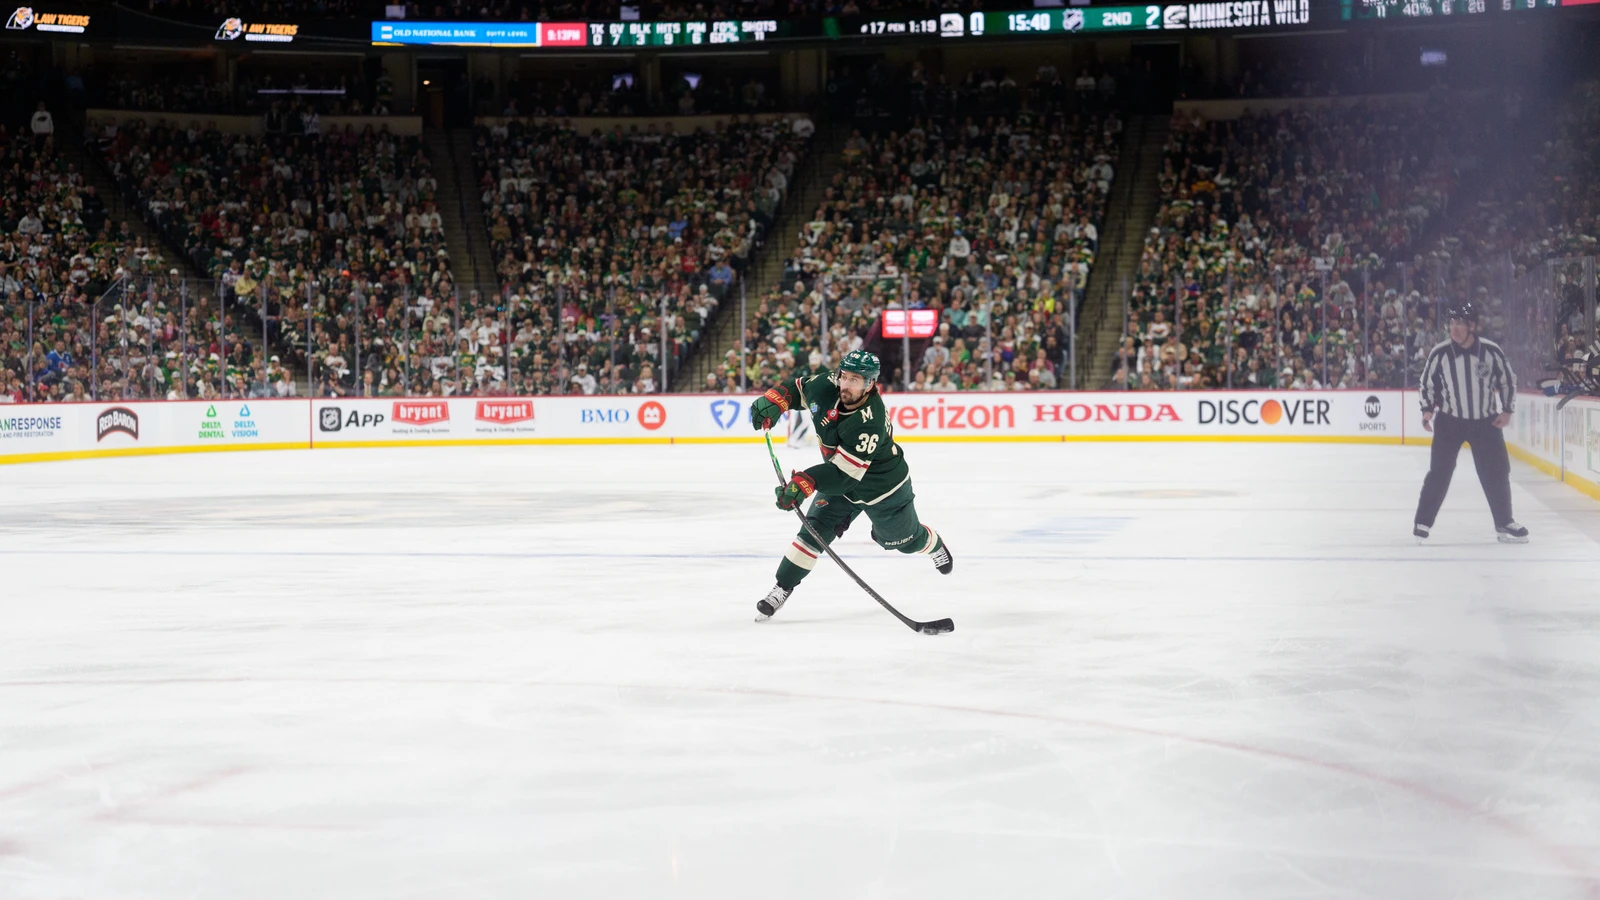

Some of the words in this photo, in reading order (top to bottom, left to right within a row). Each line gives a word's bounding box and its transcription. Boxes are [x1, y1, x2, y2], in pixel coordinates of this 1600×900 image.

[1188, 1, 1270, 29] MINNESOTA
[1274, 0, 1309, 25] WILD
[1376, 5, 1386, 18] 11
[1402, 2, 1433, 17] 40%
[34, 13, 57, 24] LAW
[58, 14, 89, 26] TIGERS
[1008, 13, 1050, 31] 15:40
[1102, 12, 1132, 26] 2ND
[1146, 6, 1160, 29] 2
[394, 29, 412, 37] OLD
[412, 29, 452, 37] NATIONAL
[590, 23, 604, 34] TK
[609, 23, 625, 34] GV
[629, 23, 652, 34] BLK
[656, 22, 681, 34] HITS
[686, 22, 706, 33] PIM
[742, 21, 777, 32] SHOTS
[887, 23, 905, 32] PEN
[909, 20, 937, 33] 1:19
[593, 34, 602, 46] 0
[611, 34, 620, 46] 7
[636, 34, 645, 46] 3
[664, 33, 674, 45] 9
[692, 32, 702, 44] 6
[710, 32, 739, 43] 60%
[754, 31, 765, 41] 11
[399, 404, 442, 420] bryant
[483, 404, 527, 420] bryant
[860, 405, 873, 423] M
[1033, 404, 1183, 422] HONDA
[1198, 400, 1331, 425] DISCOVER
[1364, 402, 1380, 413] TNT
[99, 413, 113, 435] RED
[112, 410, 136, 433] BARON
[581, 409, 629, 424] BMO
[201, 421, 222, 429] DELTA
[1359, 422, 1387, 431] SPORTS
[198, 430, 225, 438] DENTAL
[231, 429, 258, 437] VISION
[855, 433, 879, 455] 36
